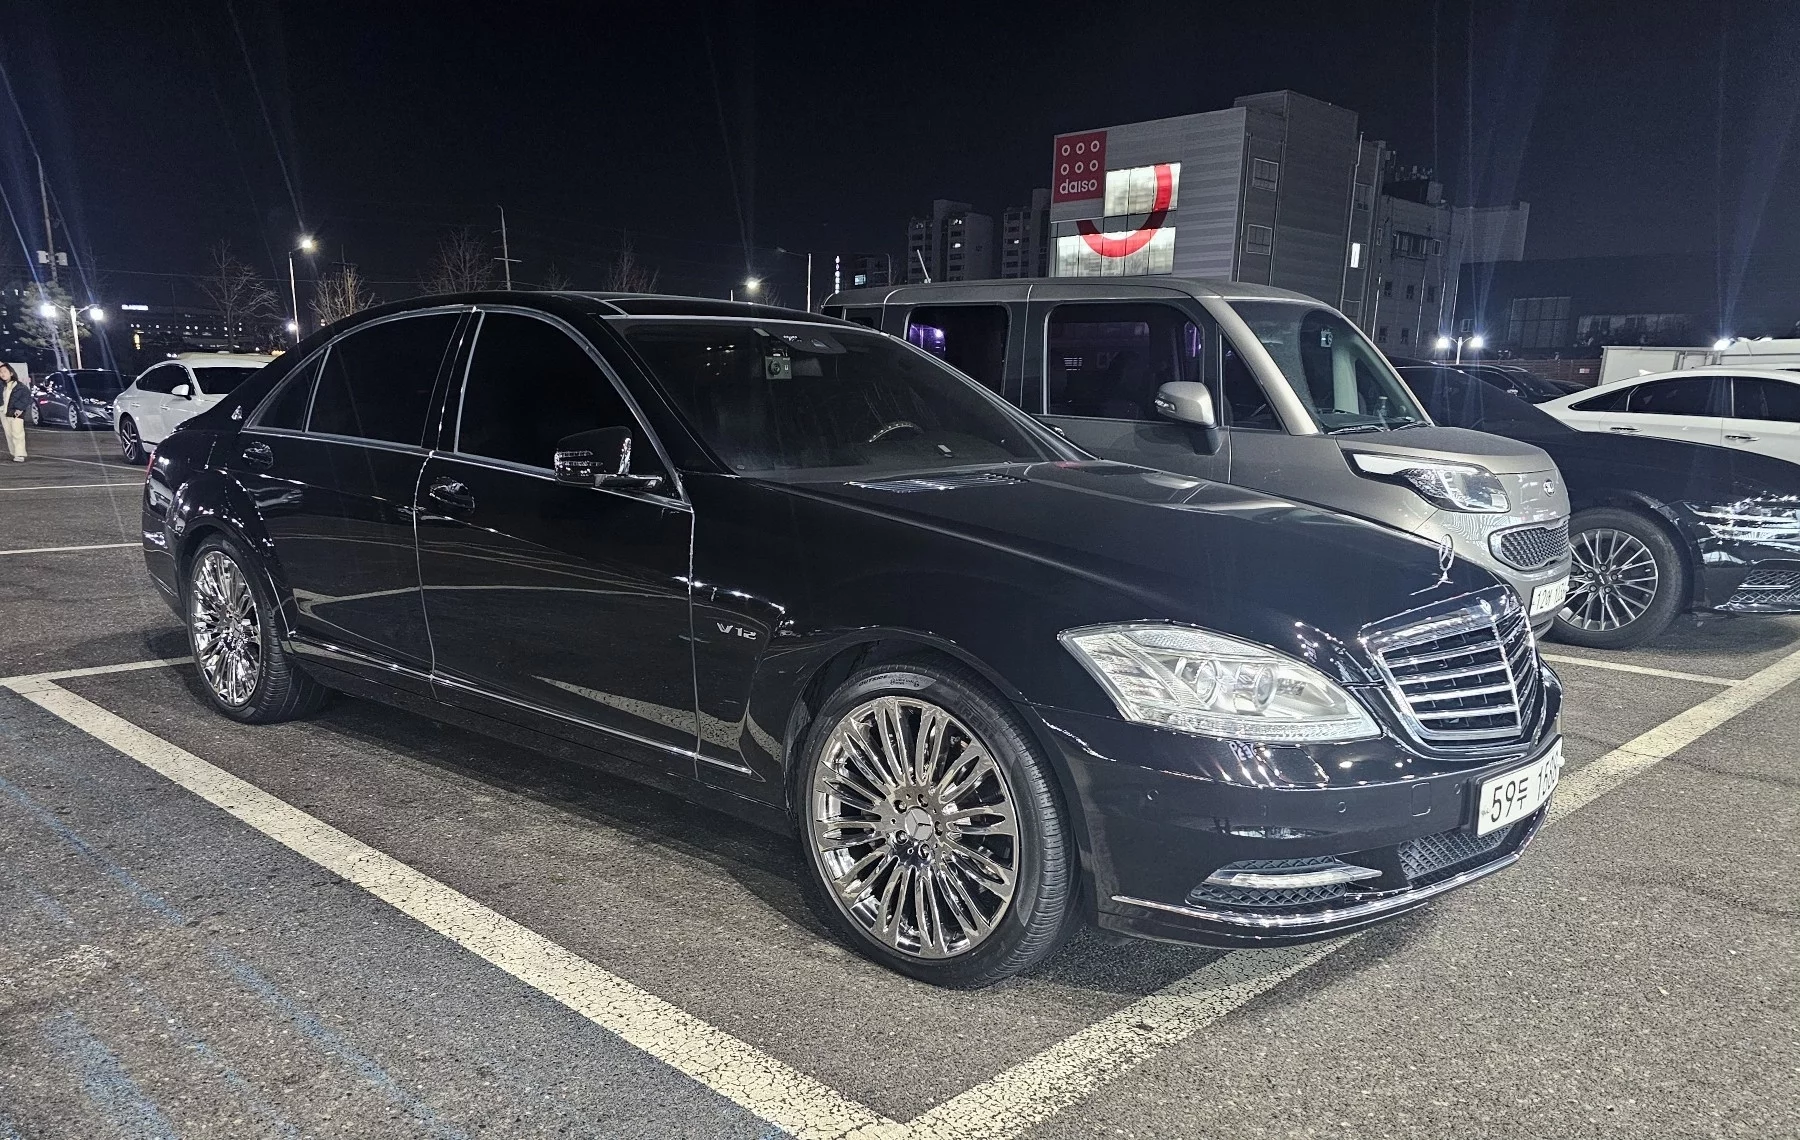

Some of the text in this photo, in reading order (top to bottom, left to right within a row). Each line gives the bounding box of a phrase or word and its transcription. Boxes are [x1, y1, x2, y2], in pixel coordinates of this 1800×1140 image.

[1060, 178, 1098, 194] daiso
[716, 622, 757, 640] V12
[1491, 777, 1529, 822] 59두
